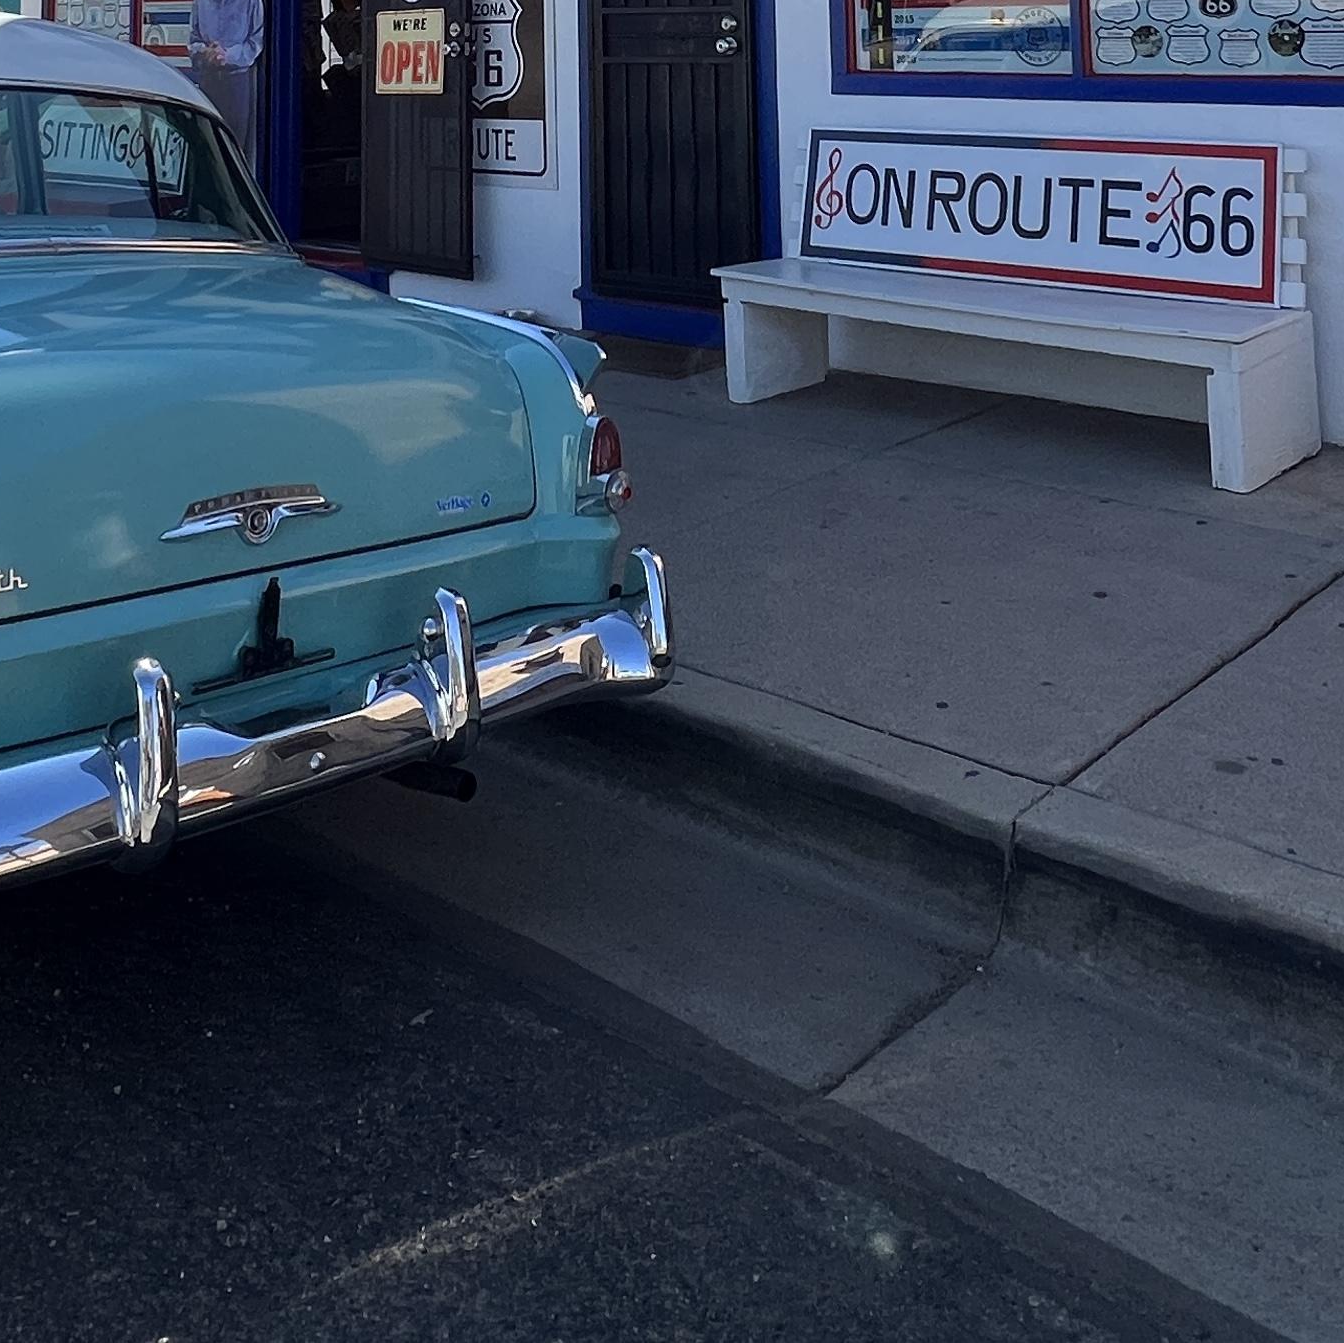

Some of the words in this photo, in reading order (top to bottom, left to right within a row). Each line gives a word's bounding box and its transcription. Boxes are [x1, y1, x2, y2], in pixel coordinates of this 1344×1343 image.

[392, 18, 428, 31] WE'RE
[380, 40, 441, 85] OPEN
[472, 50, 503, 86] 6
[845, 163, 916, 229] ON
[926, 170, 1143, 248] ROUTE
[1183, 185, 1254, 257] 66
